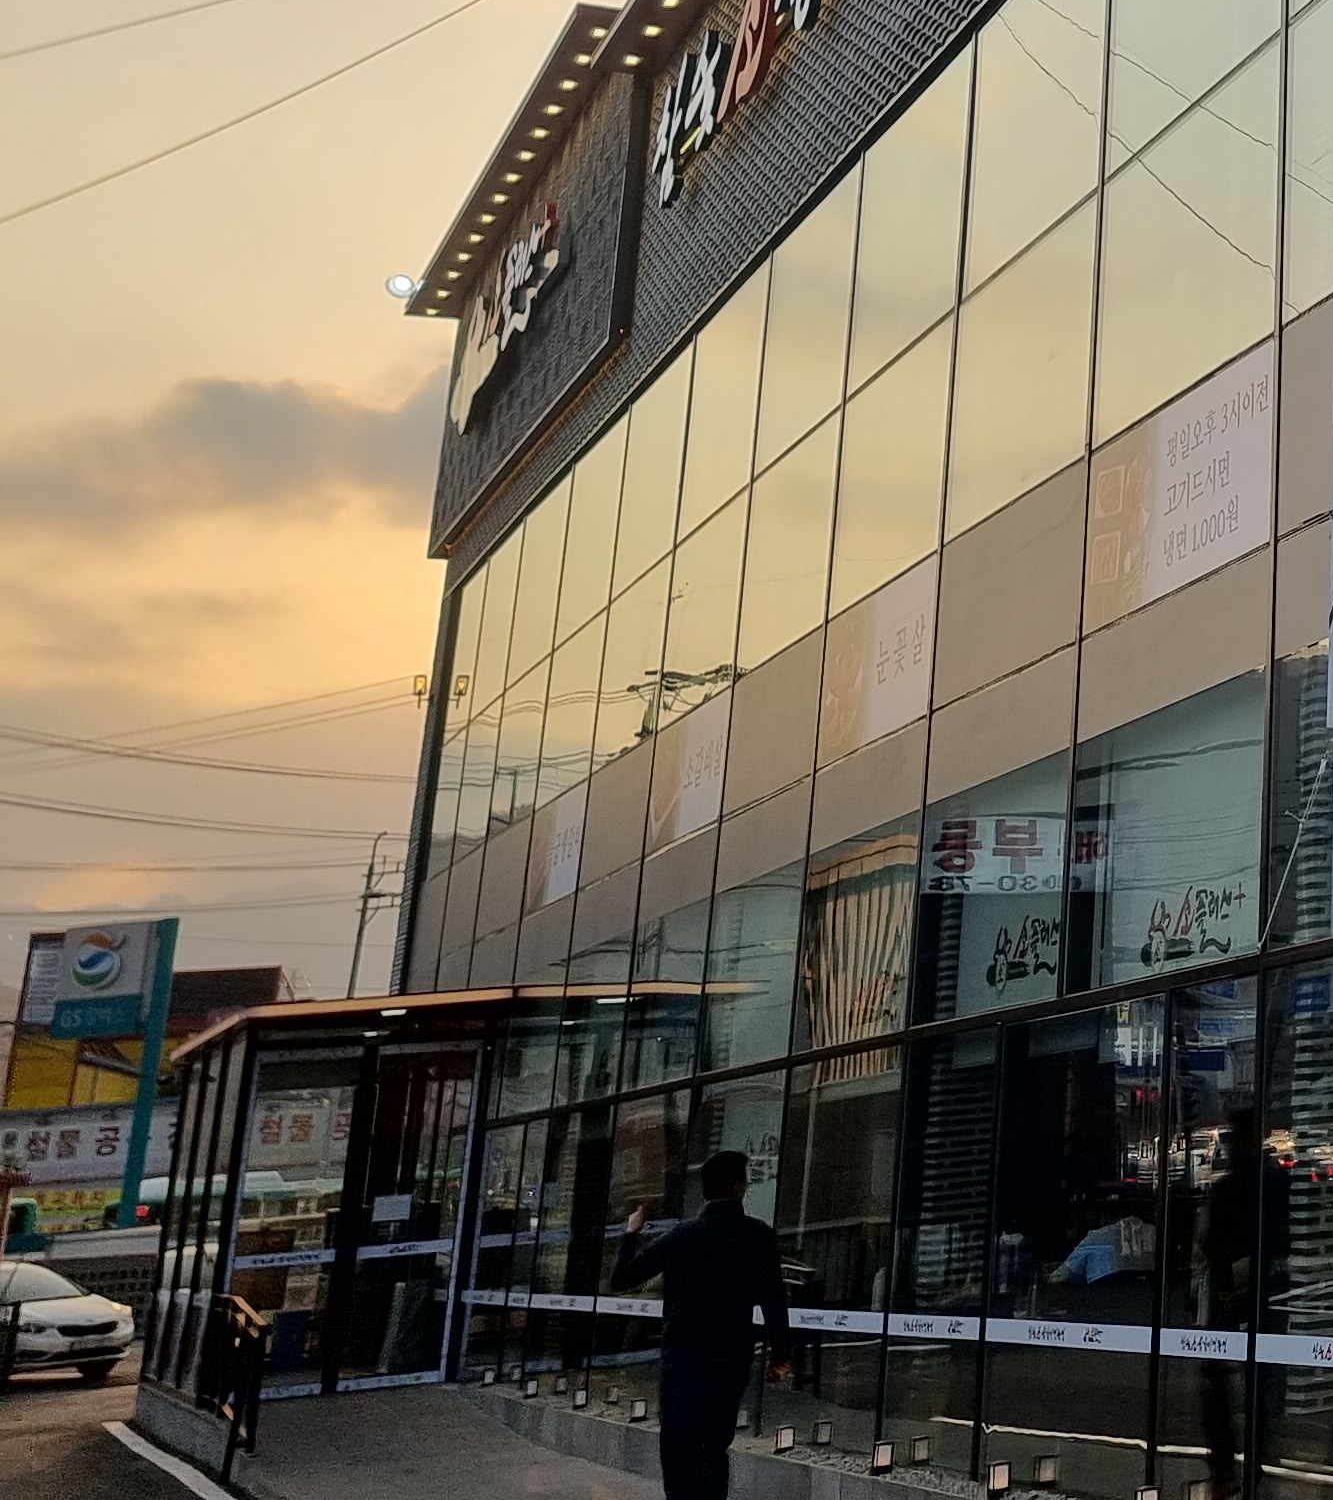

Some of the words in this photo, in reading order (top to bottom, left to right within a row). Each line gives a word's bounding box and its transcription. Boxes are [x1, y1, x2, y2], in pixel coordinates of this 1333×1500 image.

[1166, 409, 1218, 468] 평일오후
[1220, 373, 1270, 435] 3시이전
[1163, 450, 1231, 517] 고기드시면
[1163, 522, 1188, 567] 냉면
